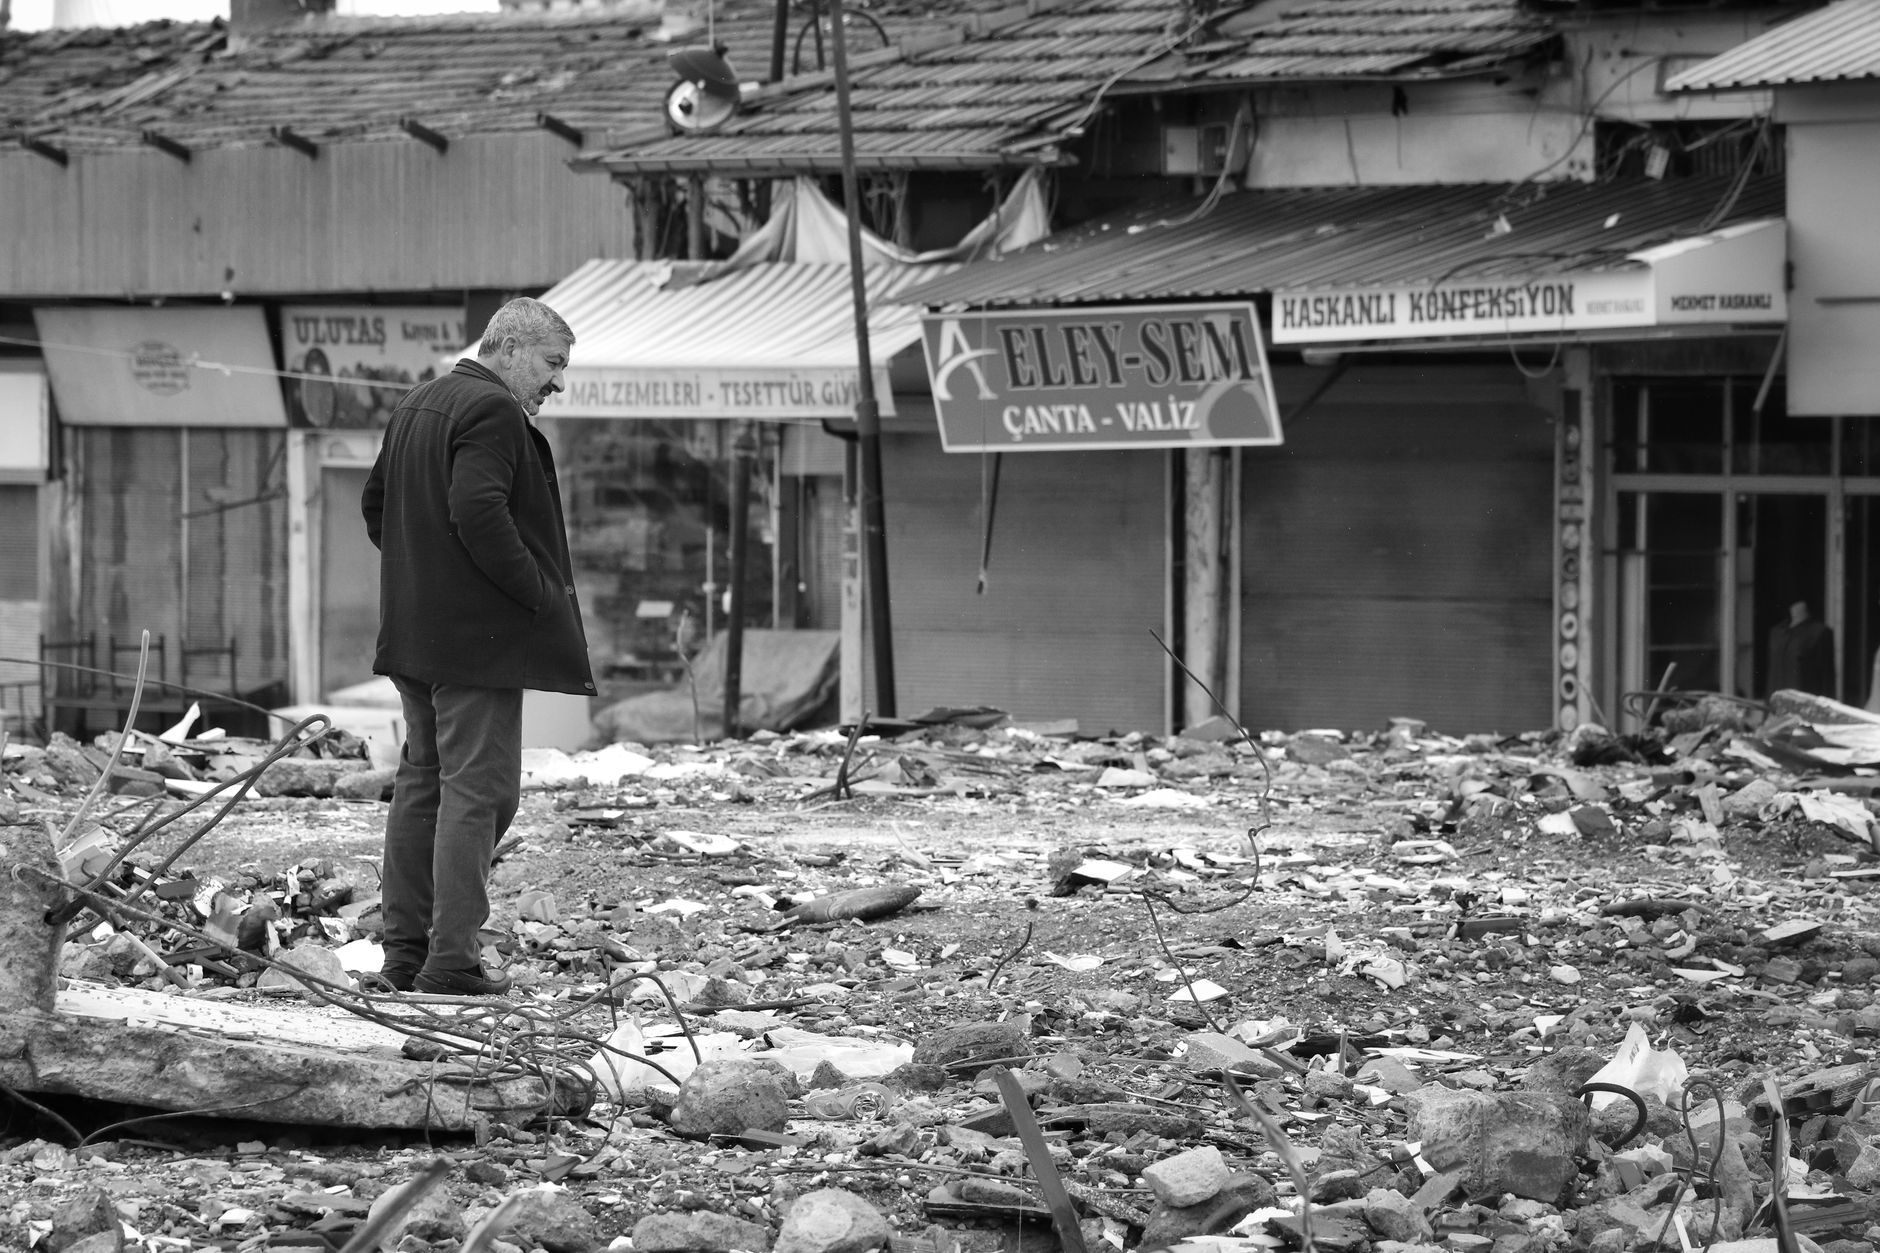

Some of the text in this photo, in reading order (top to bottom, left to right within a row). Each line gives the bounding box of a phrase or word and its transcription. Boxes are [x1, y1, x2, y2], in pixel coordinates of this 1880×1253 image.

[1282, 293, 1397, 329] HASKANLI
[293, 316, 387, 354] ULUTAŞ
[998, 316, 1254, 391] ELEY-SEM
[570, 373, 700, 407] MALZEMELERİ
[720, 373, 817, 407] TESETTÜR
[1003, 403, 1097, 442] ÇANTA
[1116, 393, 1200, 432] VALİZ
